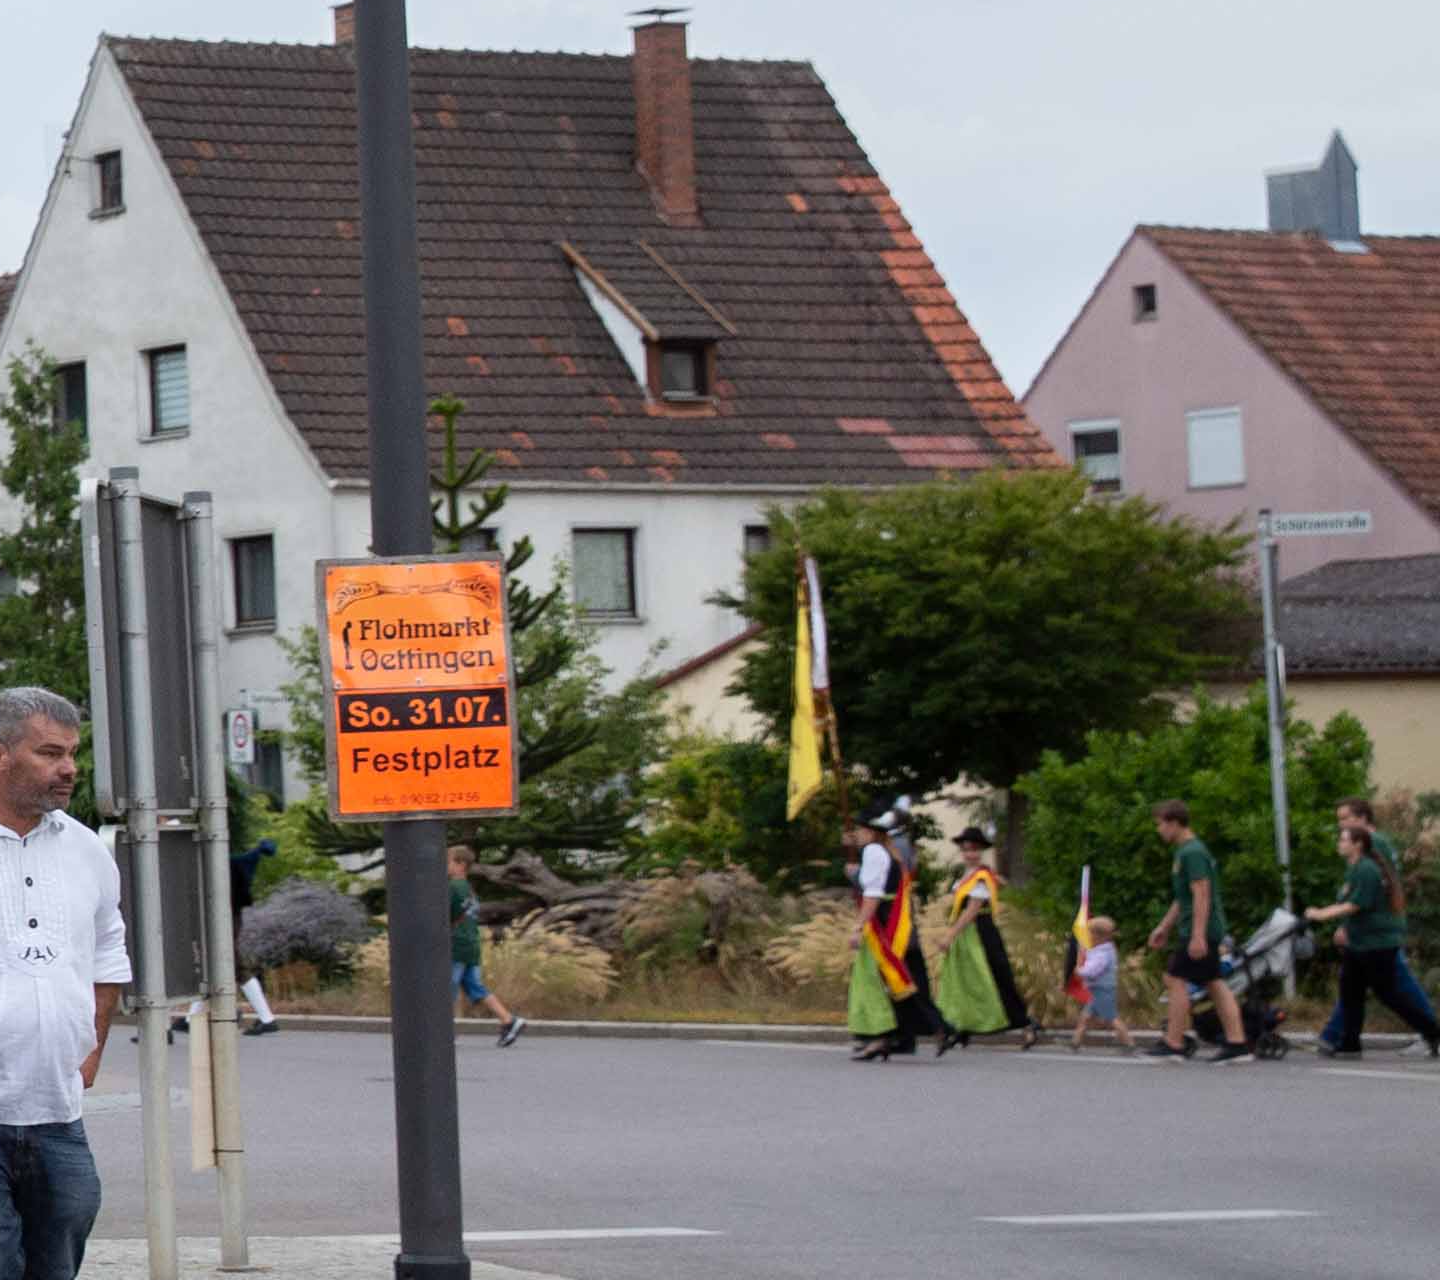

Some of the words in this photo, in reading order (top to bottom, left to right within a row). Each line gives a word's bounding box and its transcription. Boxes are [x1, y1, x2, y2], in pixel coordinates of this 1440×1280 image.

[359, 616, 491, 641] Flohmarkt
[360, 647, 495, 674] Oettingen
[347, 700, 401, 728] So.
[408, 695, 501, 726] 31.07.
[352, 743, 500, 777] Festplatz
